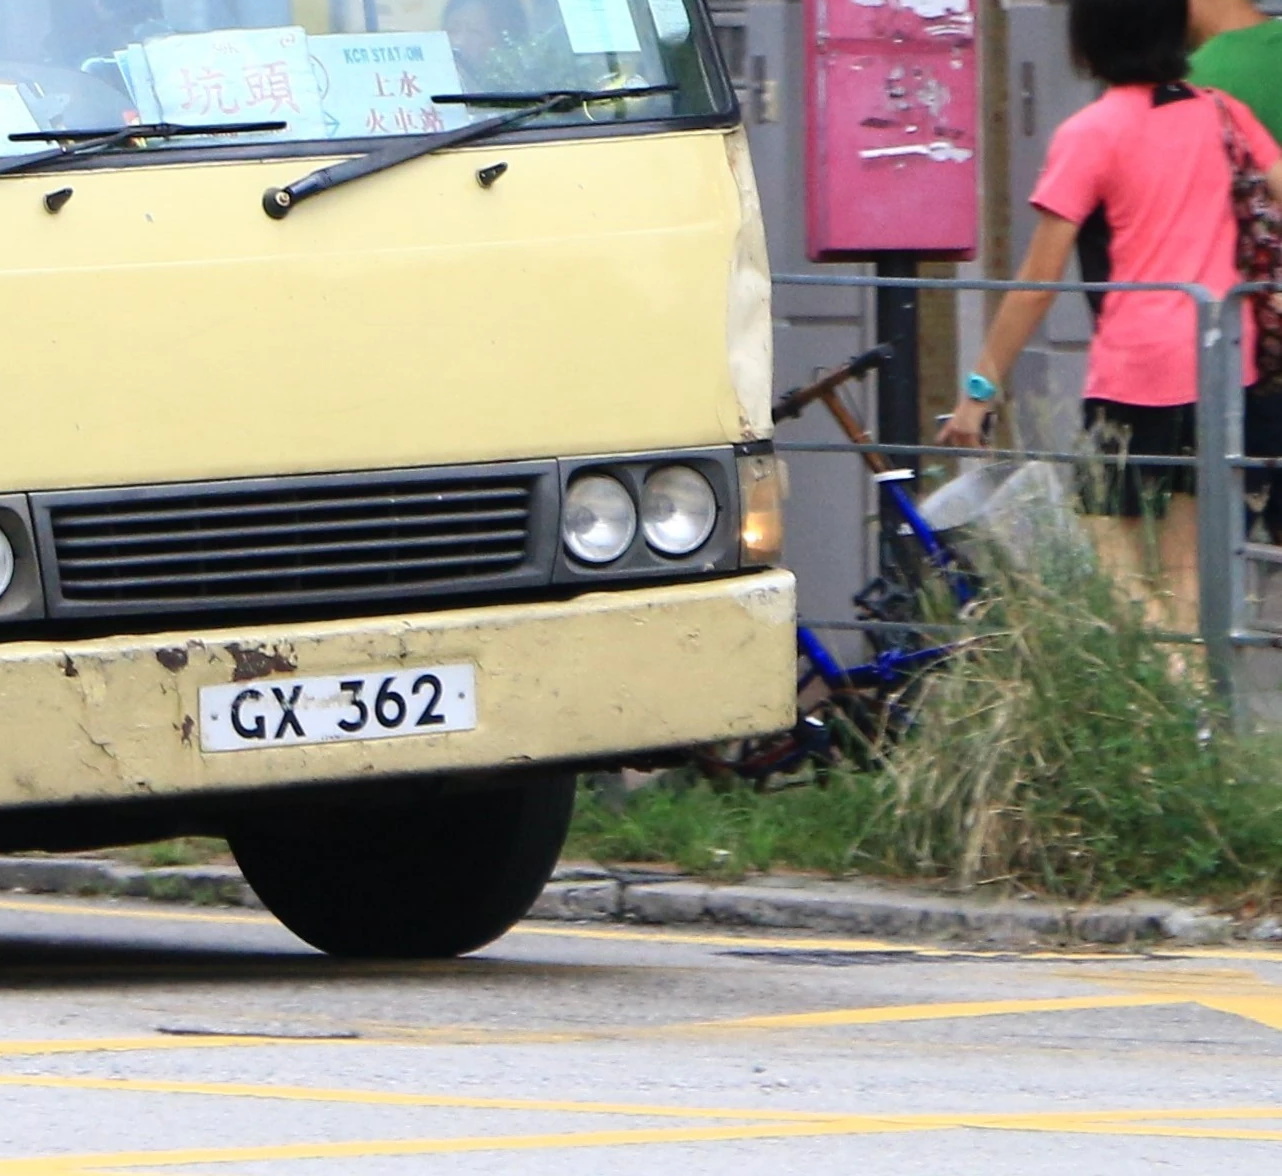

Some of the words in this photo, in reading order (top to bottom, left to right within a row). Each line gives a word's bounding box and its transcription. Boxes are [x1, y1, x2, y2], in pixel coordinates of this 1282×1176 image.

[343, 47, 370, 64] KCR
[373, 46, 424, 62] STATON
[180, 60, 301, 116] 坑頭
[374, 70, 422, 99] 上水
[366, 105, 445, 135] 火車站
[231, 684, 307, 740] GX
[336, 674, 446, 733] 362
